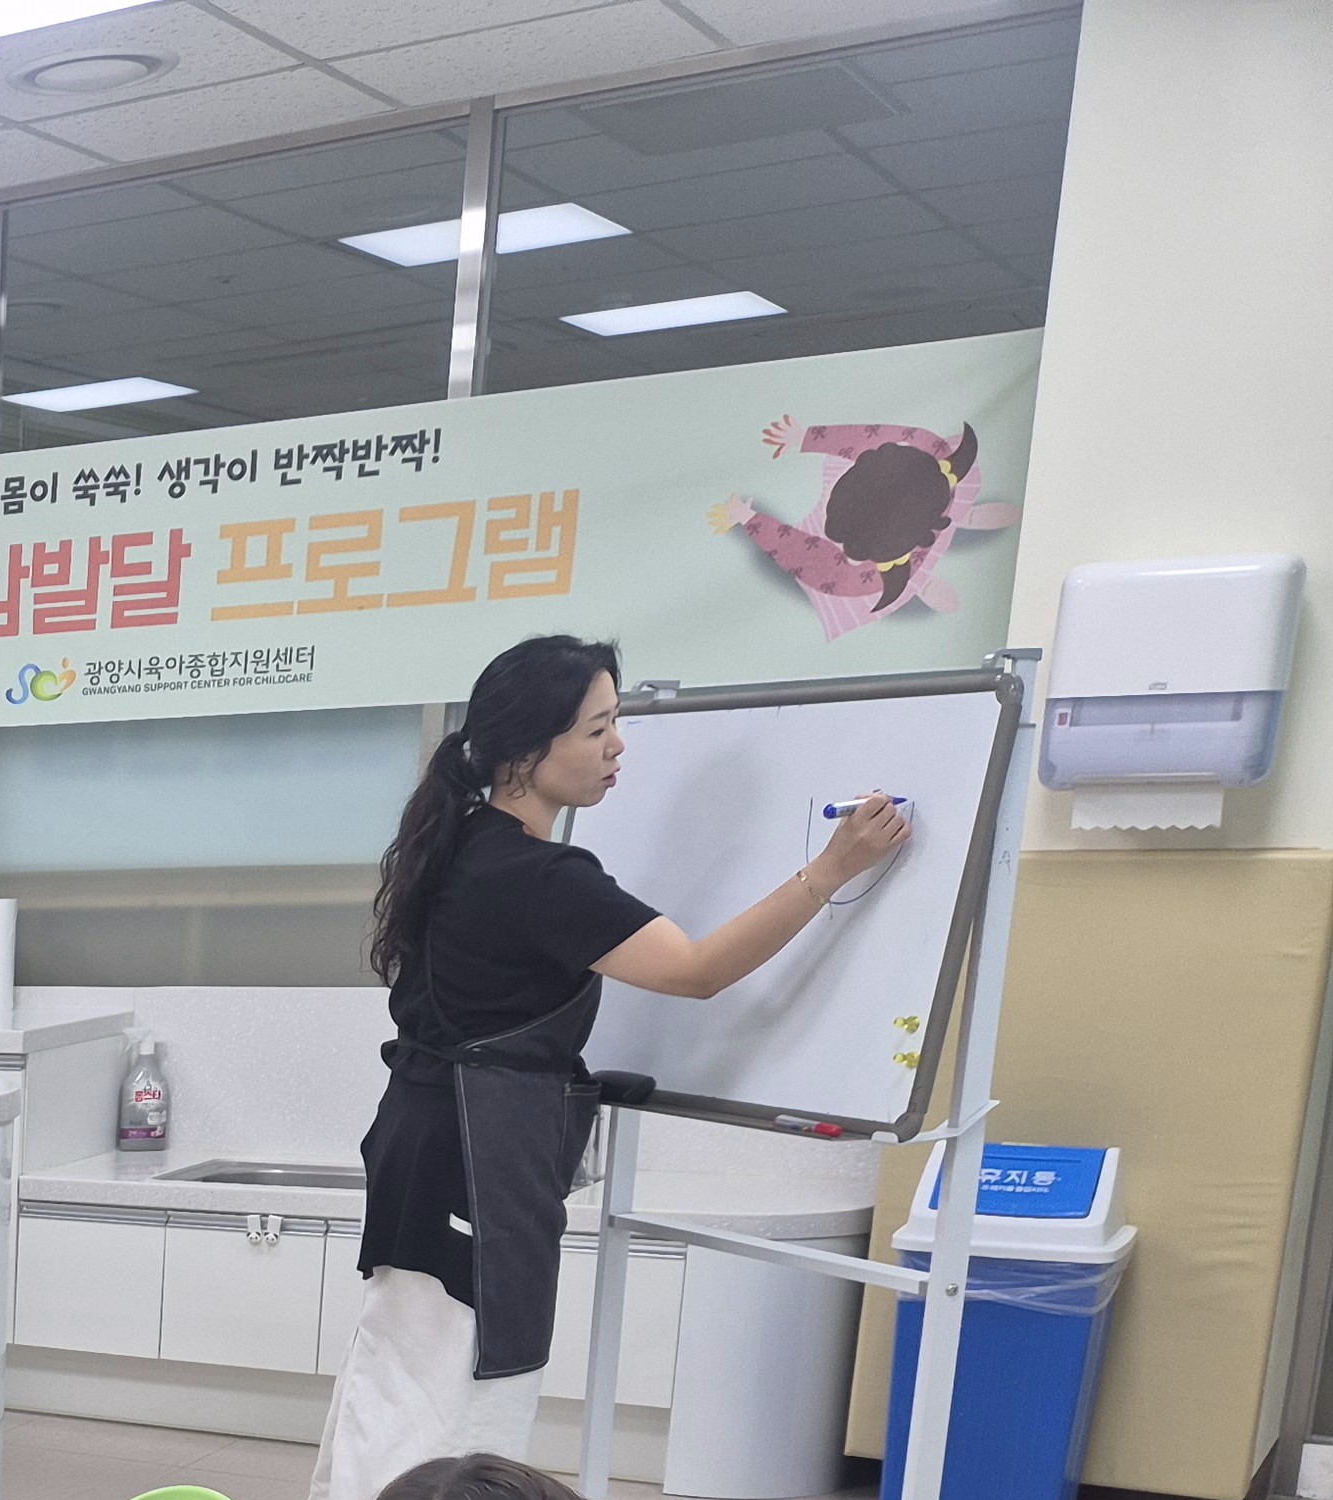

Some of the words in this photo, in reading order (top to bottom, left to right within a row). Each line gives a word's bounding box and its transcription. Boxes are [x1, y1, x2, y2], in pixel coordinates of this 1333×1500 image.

[0, 470, 58, 515] 몸이
[72, 463, 142, 508] 쑥쑥!
[156, 449, 259, 499] 생각이
[273, 428, 442, 485] 반짝반짝!
[210, 489, 581, 622] 프로그램
[82, 684, 142, 696] GWANGYANG
[143, 681, 189, 693] SUPPORT
[190, 678, 231, 690] CENTER
[232, 677, 253, 687] FOR
[253, 672, 314, 686] CHILDCARE
[83, 645, 316, 686] 광양시육아종합지원센터
